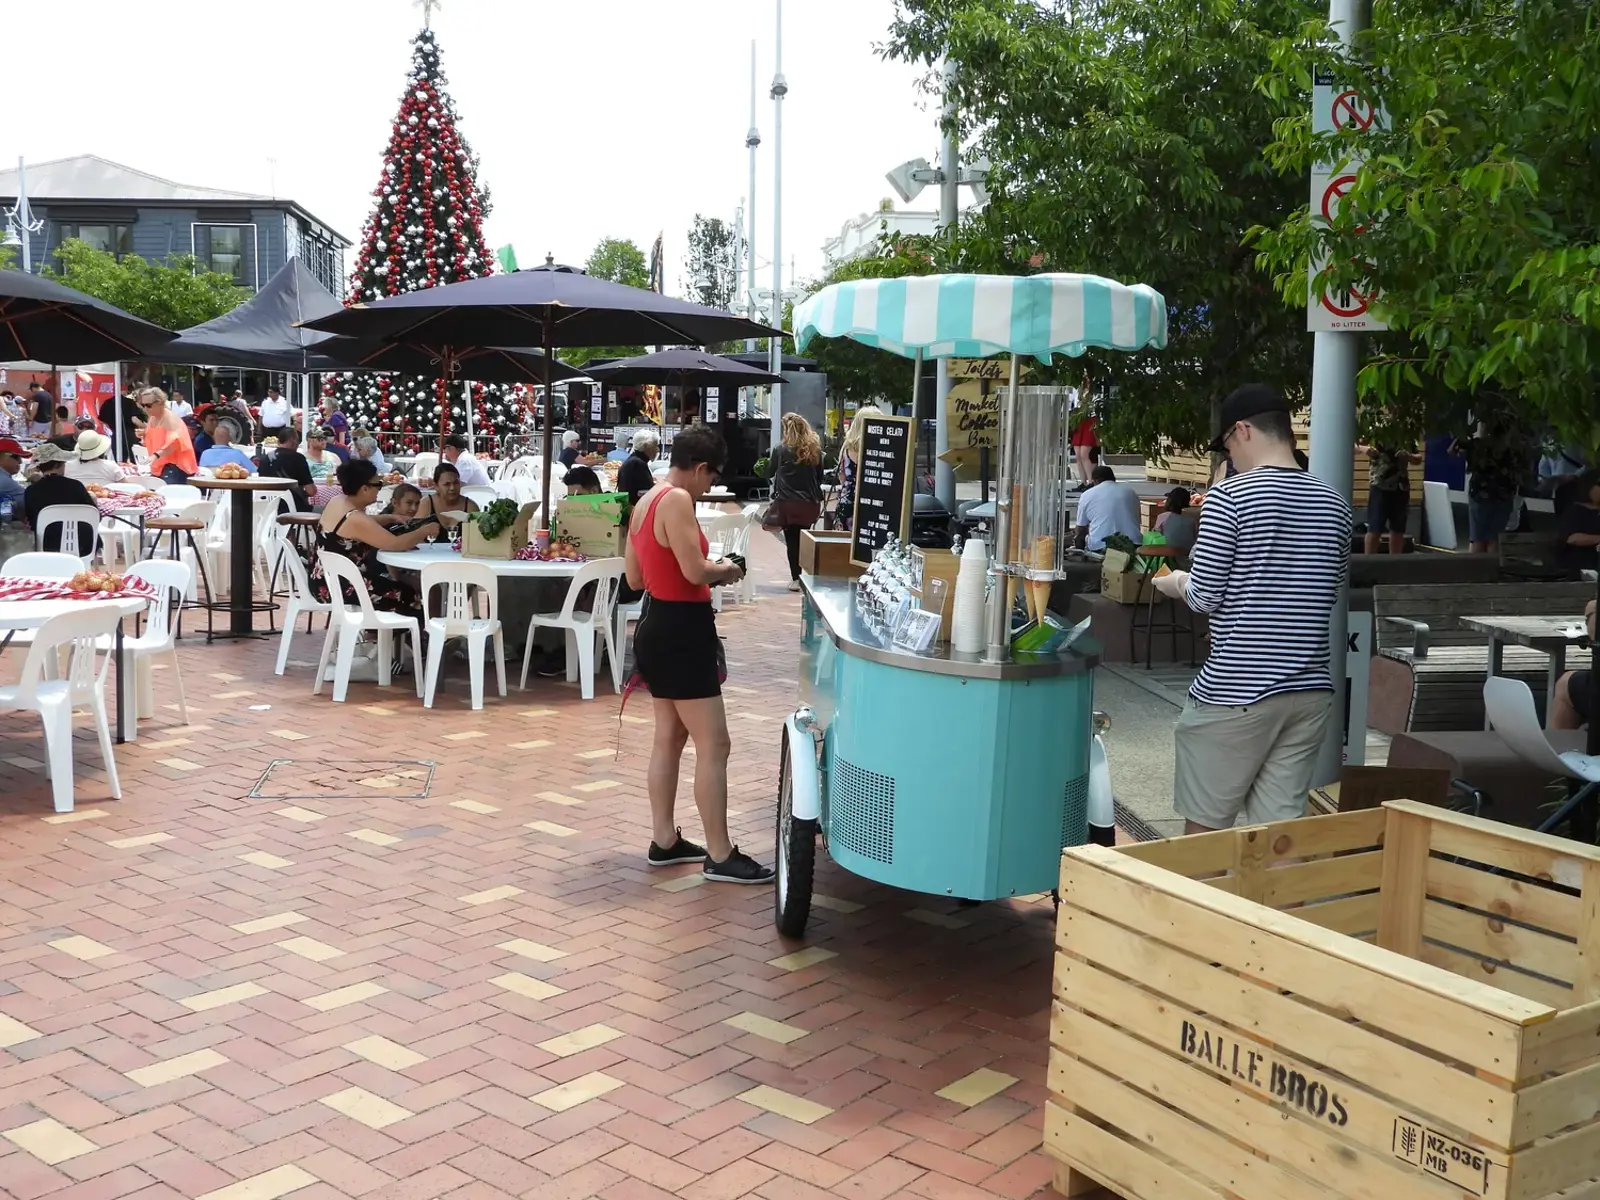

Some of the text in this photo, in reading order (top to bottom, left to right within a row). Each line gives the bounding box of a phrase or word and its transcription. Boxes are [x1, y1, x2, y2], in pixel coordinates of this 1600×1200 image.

[963, 359, 1003, 379] Toilets
[955, 394, 1001, 413] Market
[959, 413, 998, 431] Coffee
[968, 430, 993, 447] Bar
[1181, 1020, 1348, 1126] BALLE BROS
[1426, 1152, 1448, 1173] MB
[1427, 1135, 1482, 1171] NZ-036
